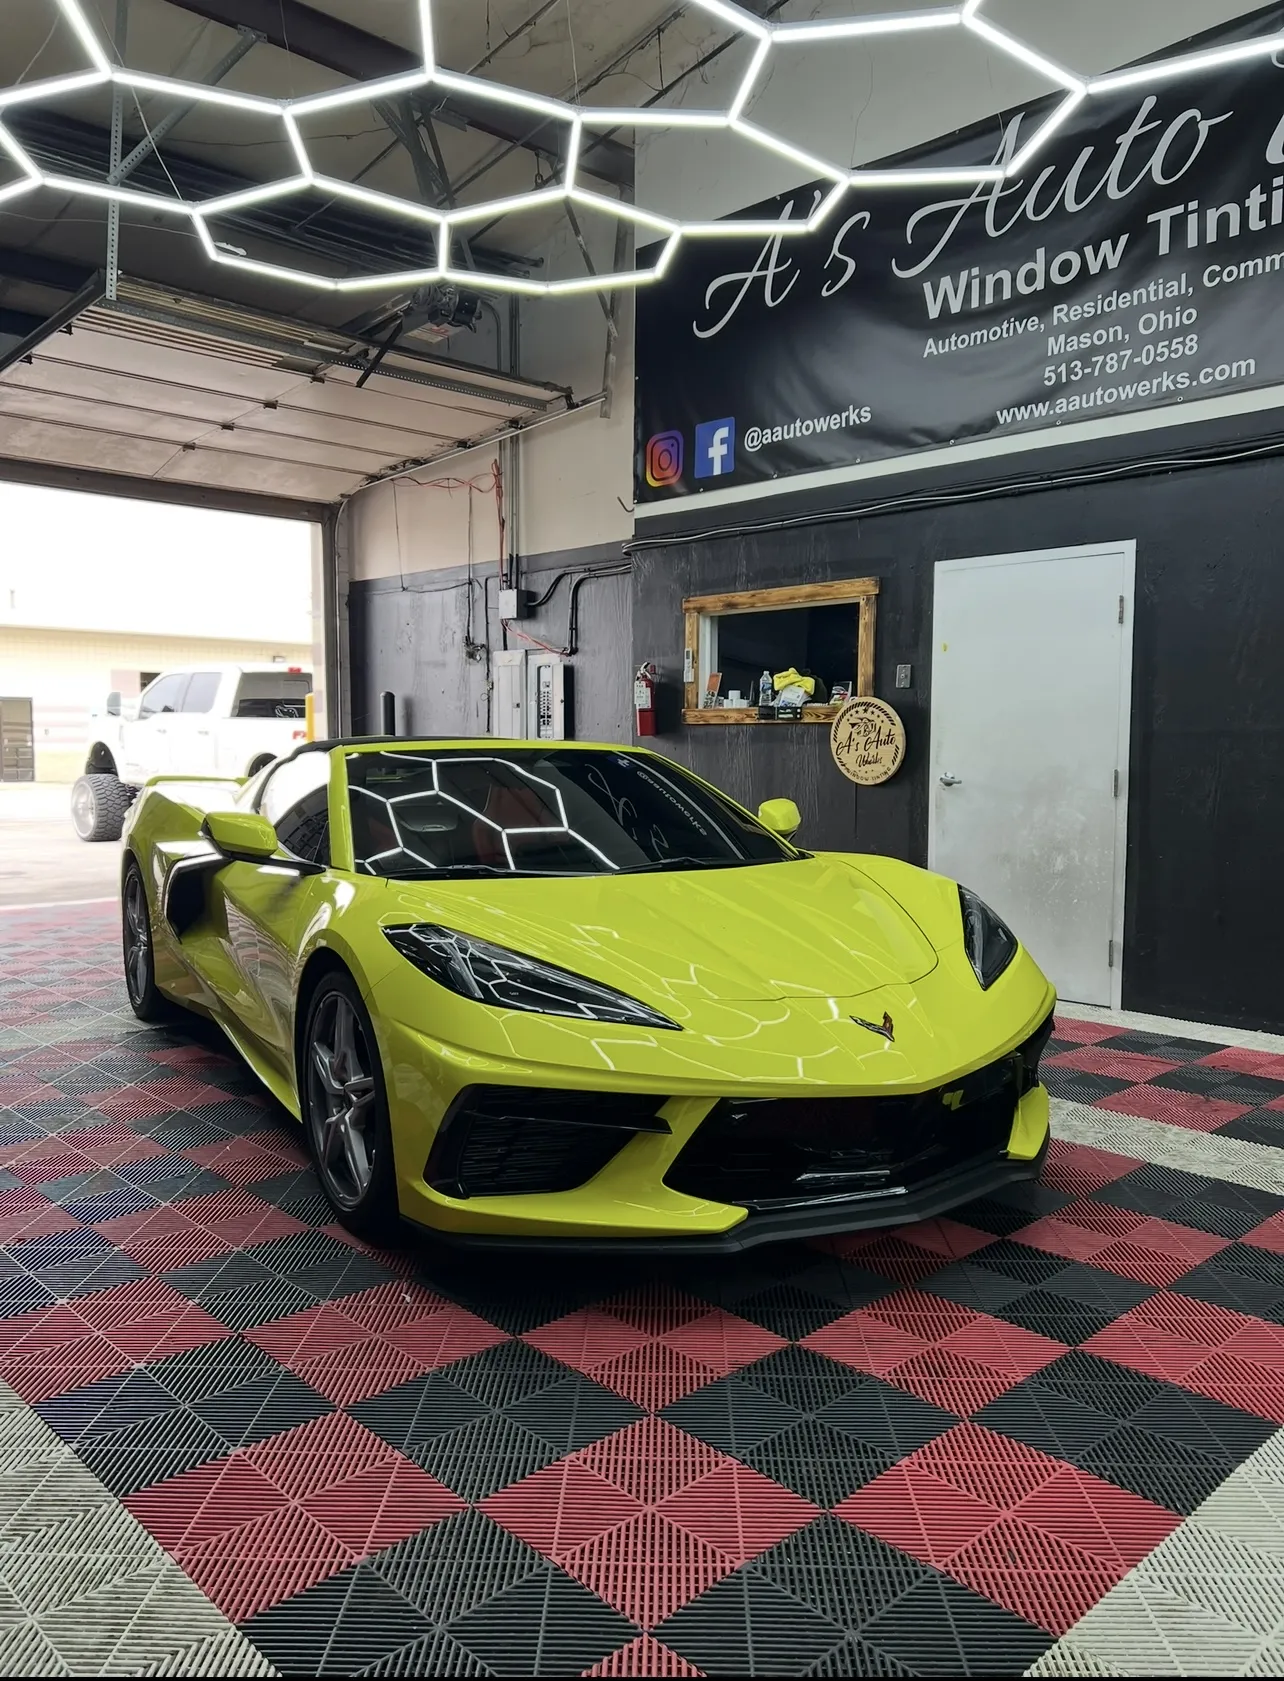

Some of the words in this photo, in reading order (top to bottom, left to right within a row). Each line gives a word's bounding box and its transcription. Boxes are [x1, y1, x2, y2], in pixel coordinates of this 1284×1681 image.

[692, 189, 871, 339] A's
[891, 94, 1234, 280] Auto
[922, 233, 1130, 320] Window
[1146, 175, 1284, 257] Tinti
[922, 314, 1046, 359] Automotive,
[1052, 272, 1194, 326] Residential,
[1202, 252, 1284, 288] Comm
[1046, 324, 1130, 357] Mason,
[1138, 306, 1199, 336] Ohio
[1043, 333, 1199, 387] 513-787-0558
[995, 357, 1257, 426] www.aautowerks.com
[744, 404, 872, 452] @aautowerks
[863, 725, 896, 752] Auto
